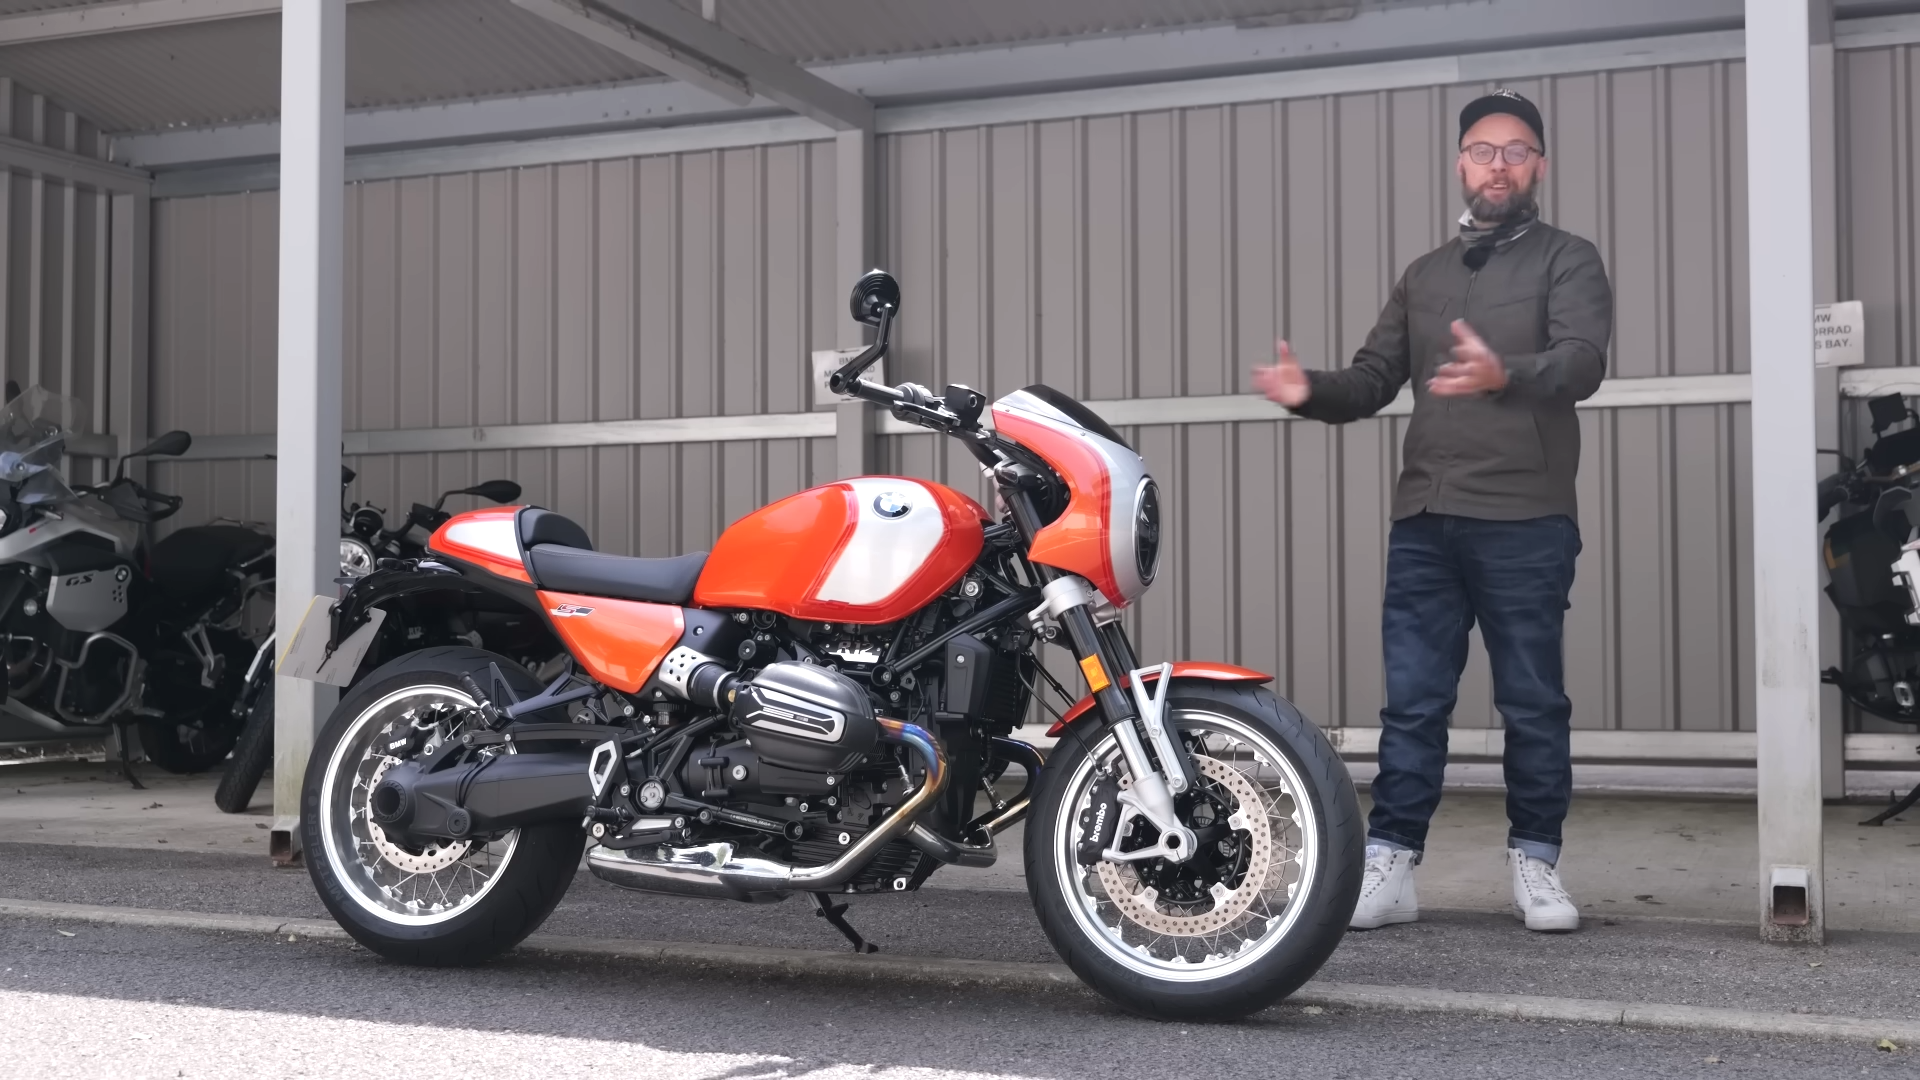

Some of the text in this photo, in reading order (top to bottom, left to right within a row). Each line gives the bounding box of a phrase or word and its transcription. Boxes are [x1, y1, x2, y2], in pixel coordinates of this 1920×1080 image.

[65, 573, 94, 586] GS
[390, 737, 407, 750] BMW
[1089, 802, 1107, 843] brembo
[307, 812, 345, 902] METZELER
